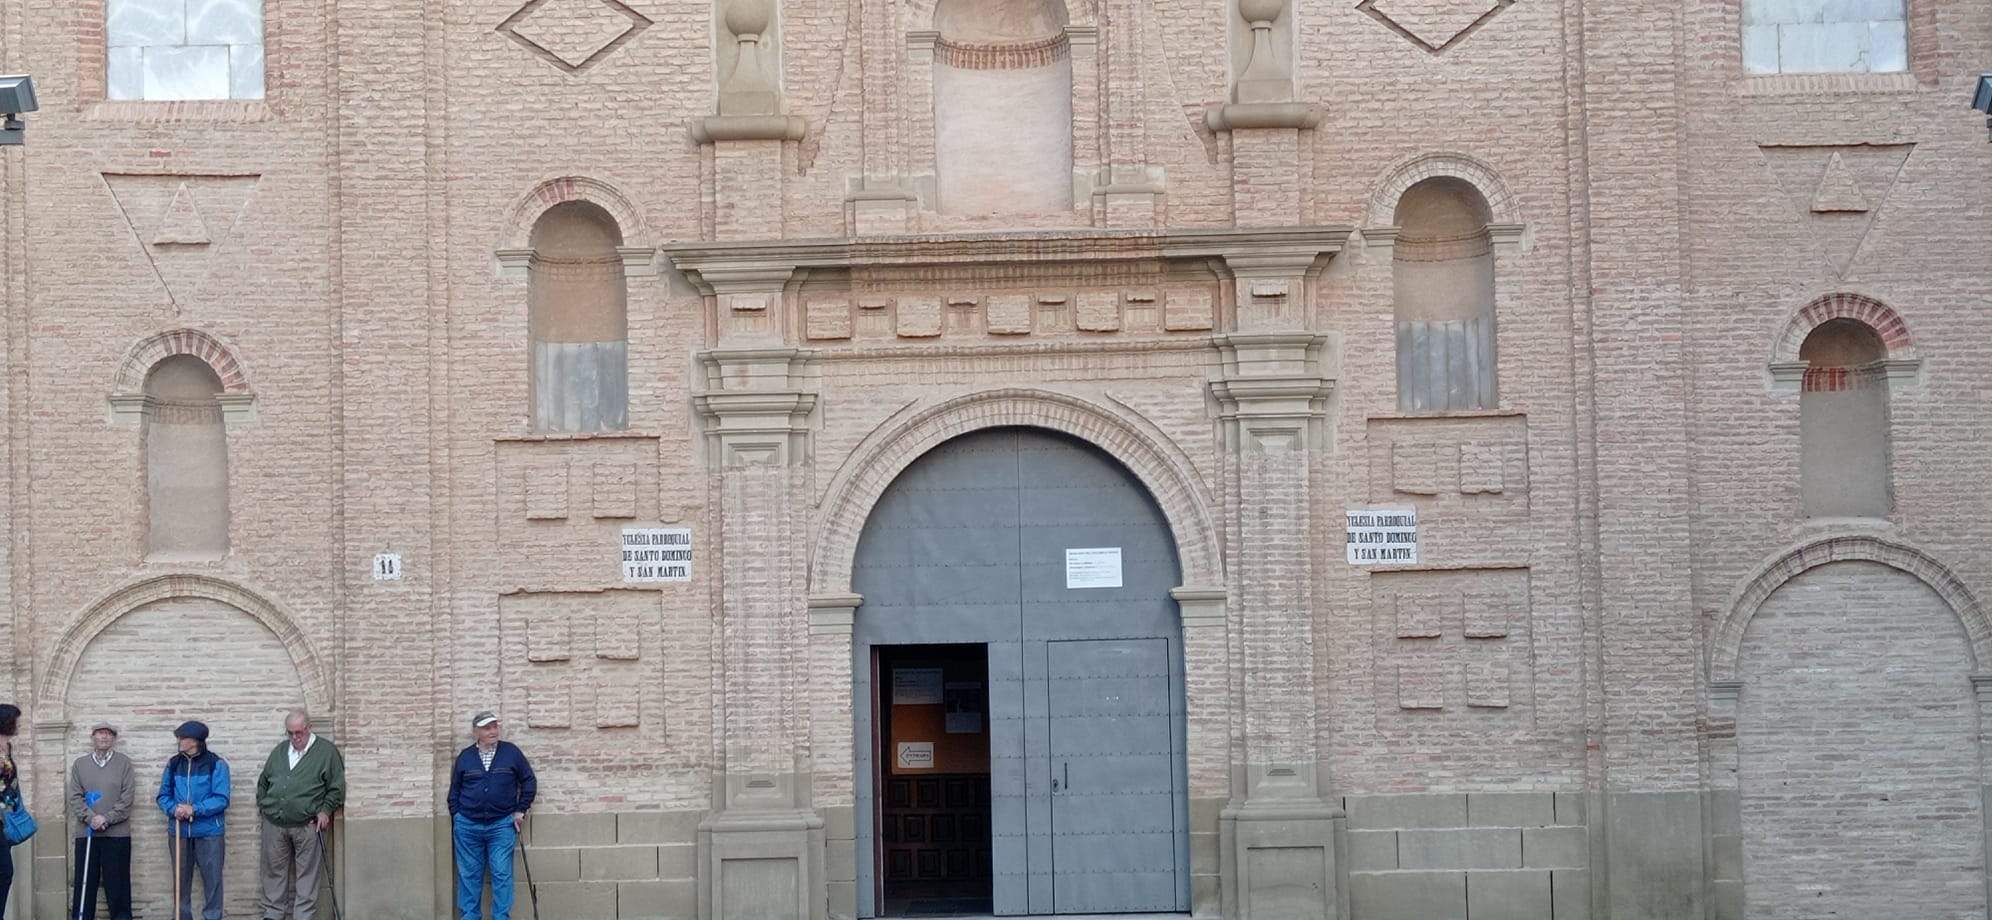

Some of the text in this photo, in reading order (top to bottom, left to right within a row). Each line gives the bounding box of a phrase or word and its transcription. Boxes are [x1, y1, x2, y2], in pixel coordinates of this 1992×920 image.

[1346, 532, 1417, 543] DE SANTO DOMINGO
[622, 550, 692, 561] DE SANTO DOMINGO
[1354, 548, 1411, 560] Y SAN MARTIN
[630, 566, 686, 578] Y SAN MARTIN
